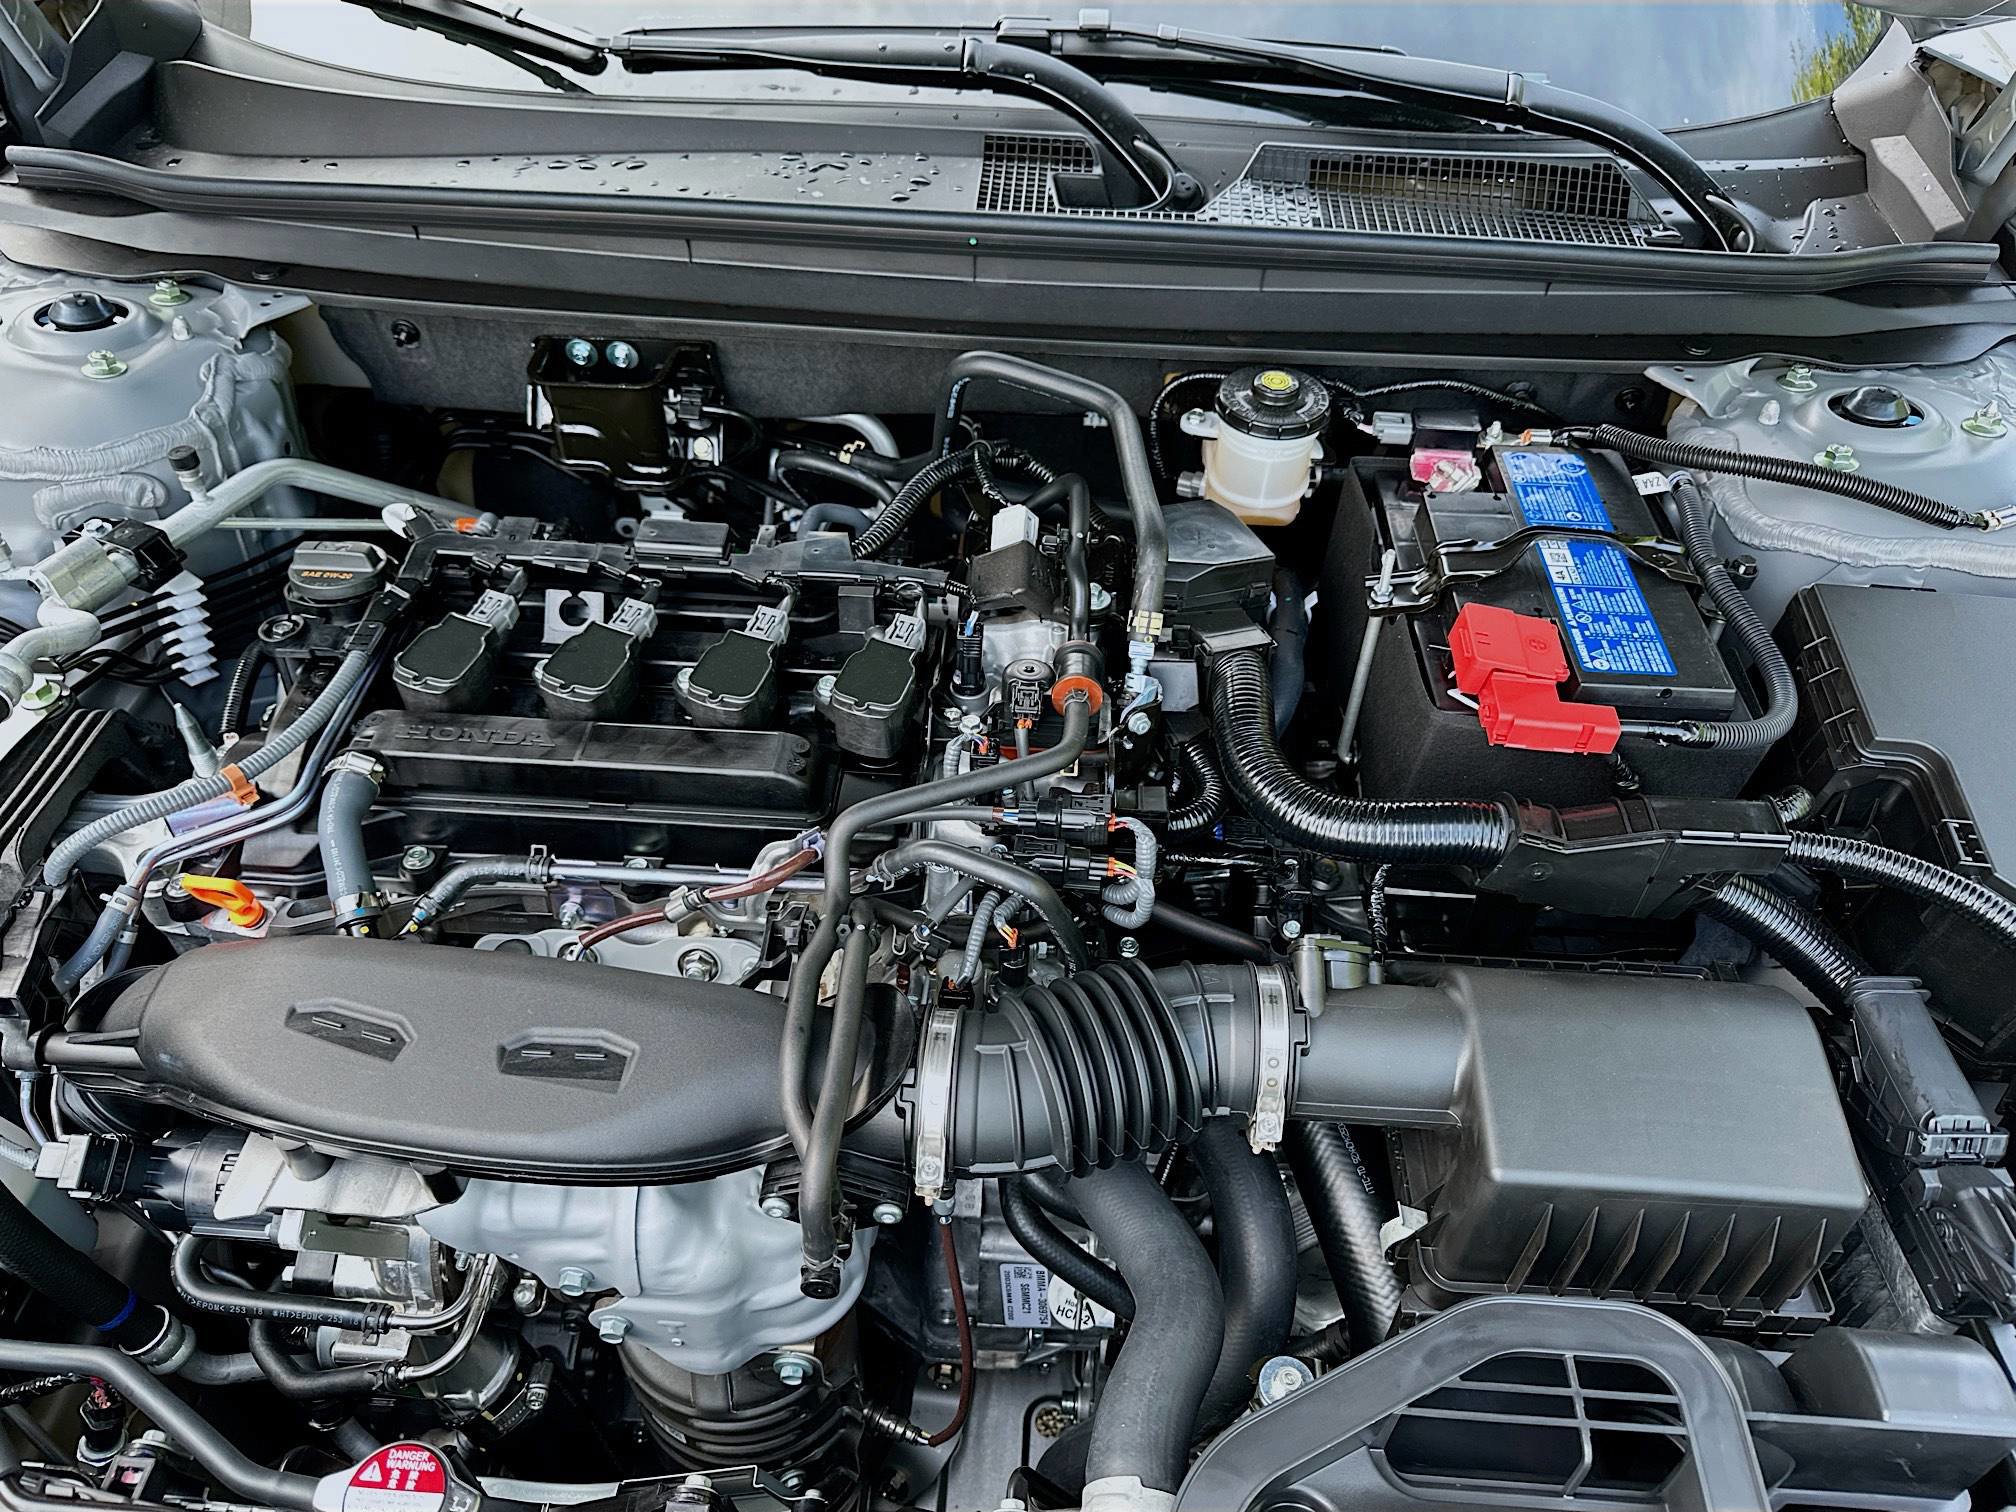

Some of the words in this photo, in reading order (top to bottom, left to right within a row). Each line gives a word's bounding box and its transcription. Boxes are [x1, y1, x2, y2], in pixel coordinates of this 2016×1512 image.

[301, 570, 323, 578] SAE
[323, 571, 353, 580] 0W-20
[395, 723, 556, 748] HONDA
[229, 1305, 247, 1315] 253
[388, 1448, 431, 1462] DANGER
[386, 1458, 436, 1472] WARNUNG
